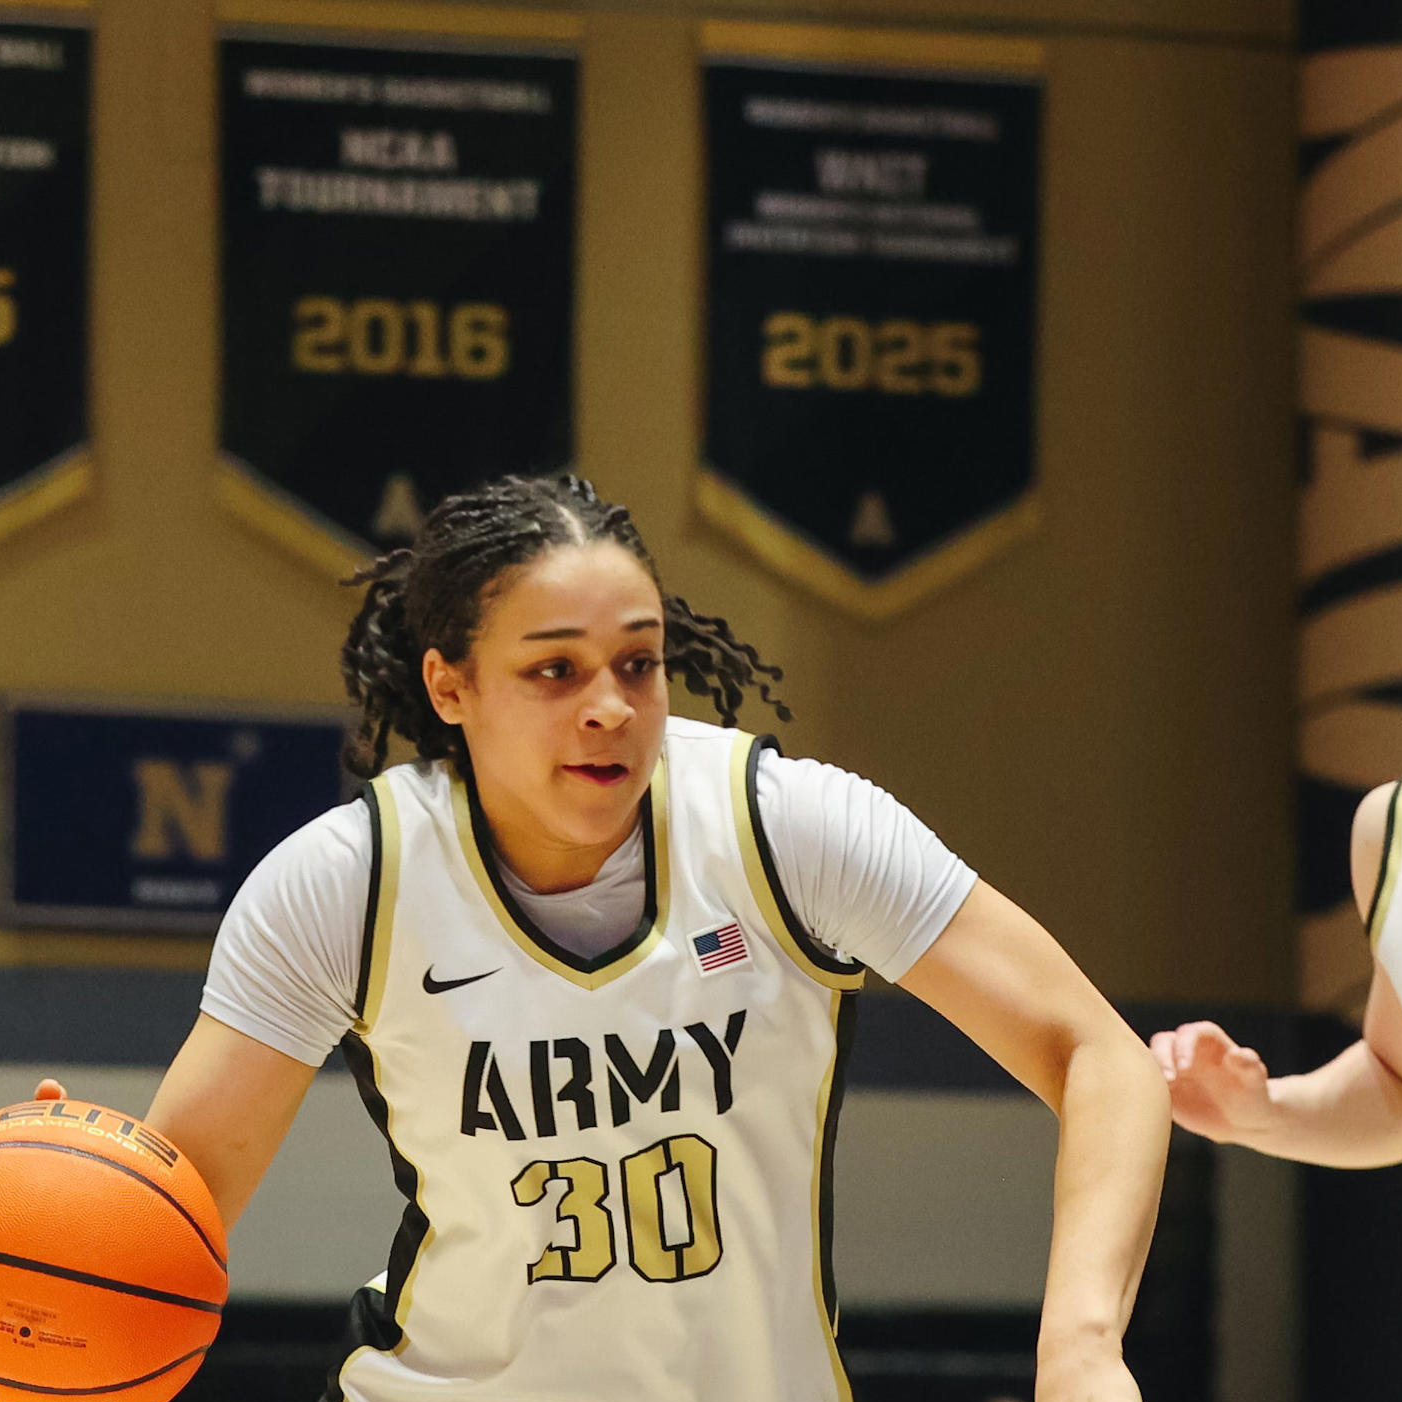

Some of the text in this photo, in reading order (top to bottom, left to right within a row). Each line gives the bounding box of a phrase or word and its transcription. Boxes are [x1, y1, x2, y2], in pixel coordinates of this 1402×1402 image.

[255, 167, 540, 222] TOURNAMENT
[293, 295, 510, 379] 2016
[760, 311, 984, 396] 2025
[131, 759, 234, 860] N
[460, 1008, 748, 1142] ARMY
[509, 1133, 724, 1286] 30
